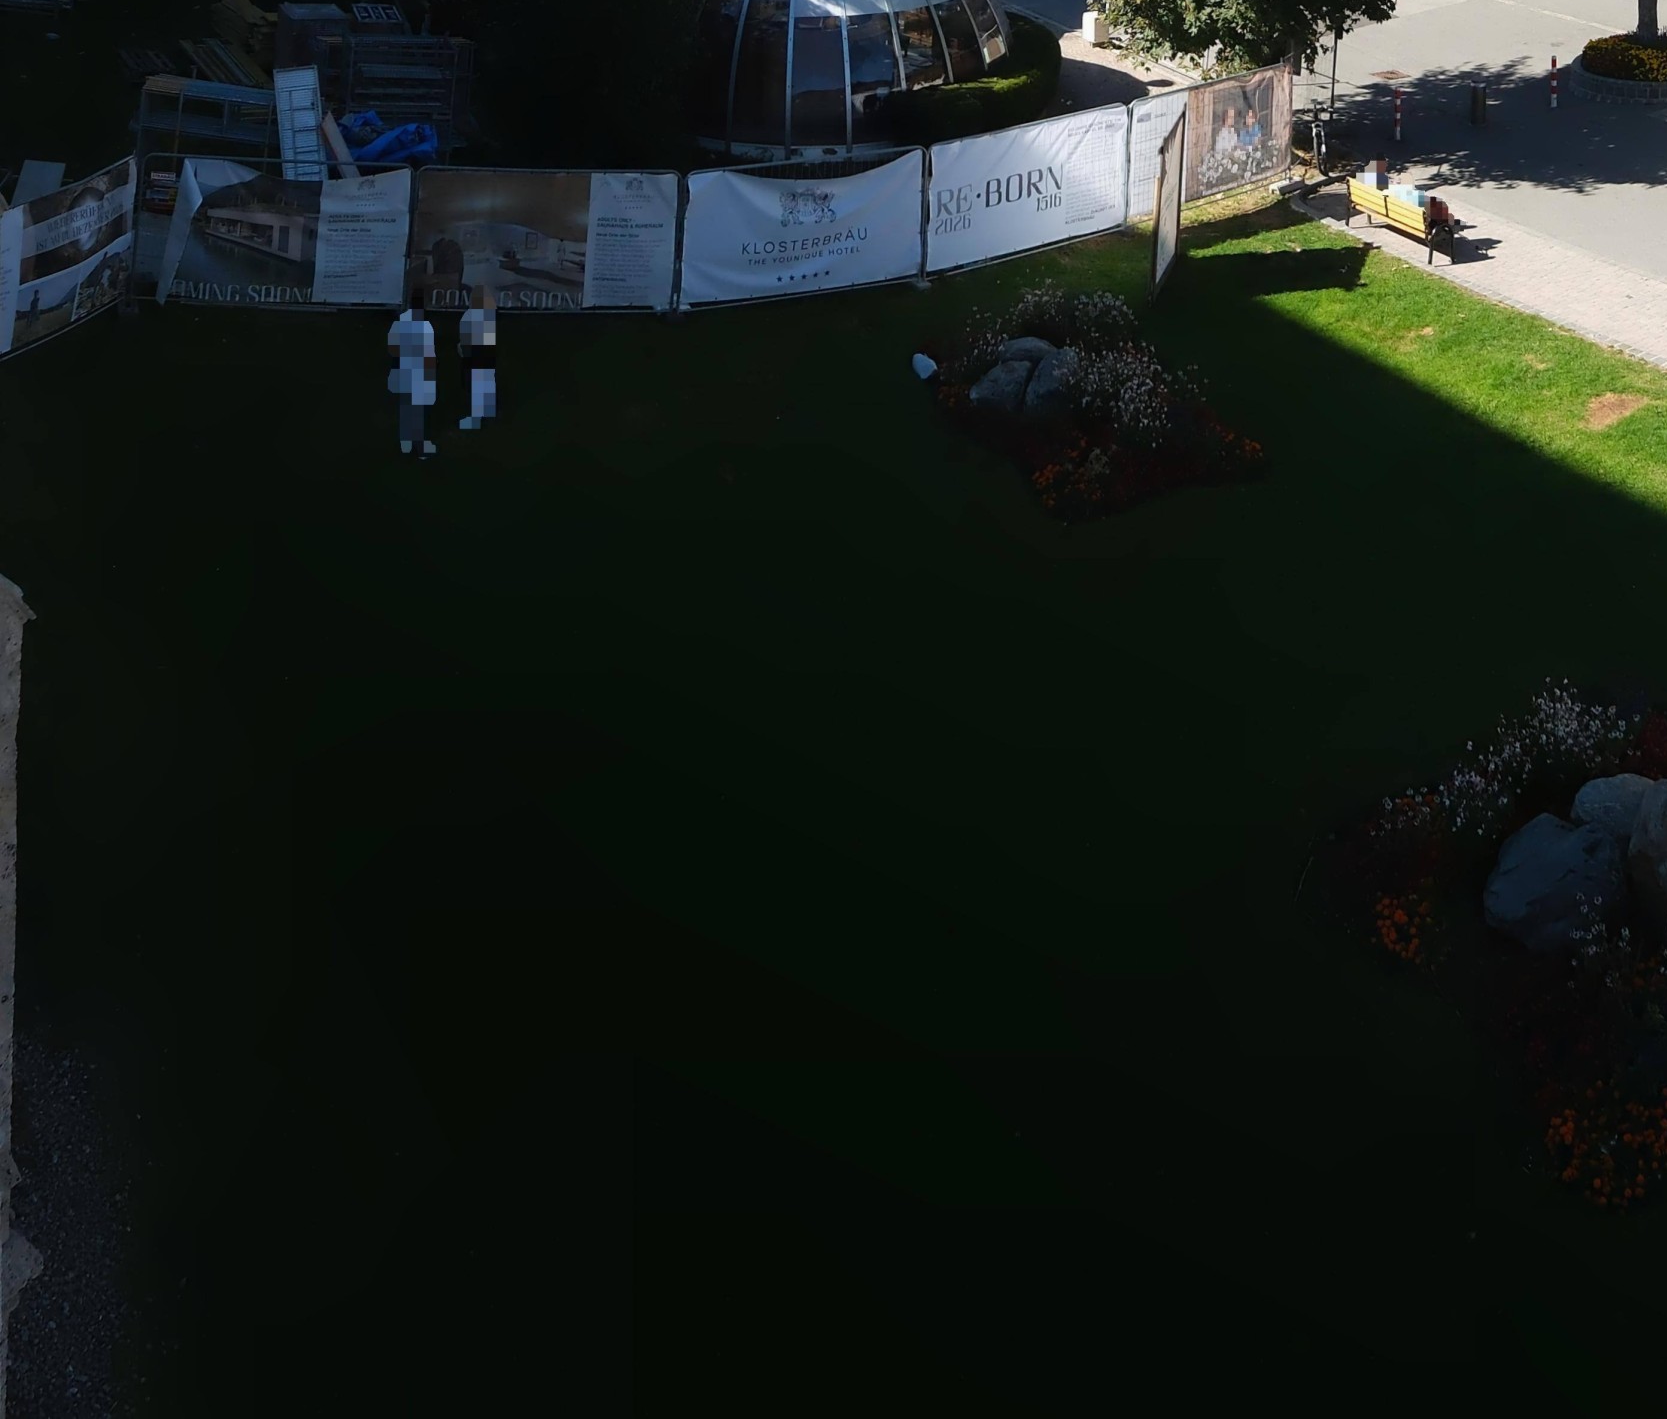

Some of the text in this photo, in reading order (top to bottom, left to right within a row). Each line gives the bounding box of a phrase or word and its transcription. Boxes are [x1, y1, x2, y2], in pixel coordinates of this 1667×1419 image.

[1037, 192, 1062, 212] 1516
[935, 213, 971, 235] 2026
[741, 227, 868, 255] KLOSTERBRÄU
[748, 246, 861, 266] THE YOUNIQUE HOTEL
[169, 279, 240, 303] OMING
